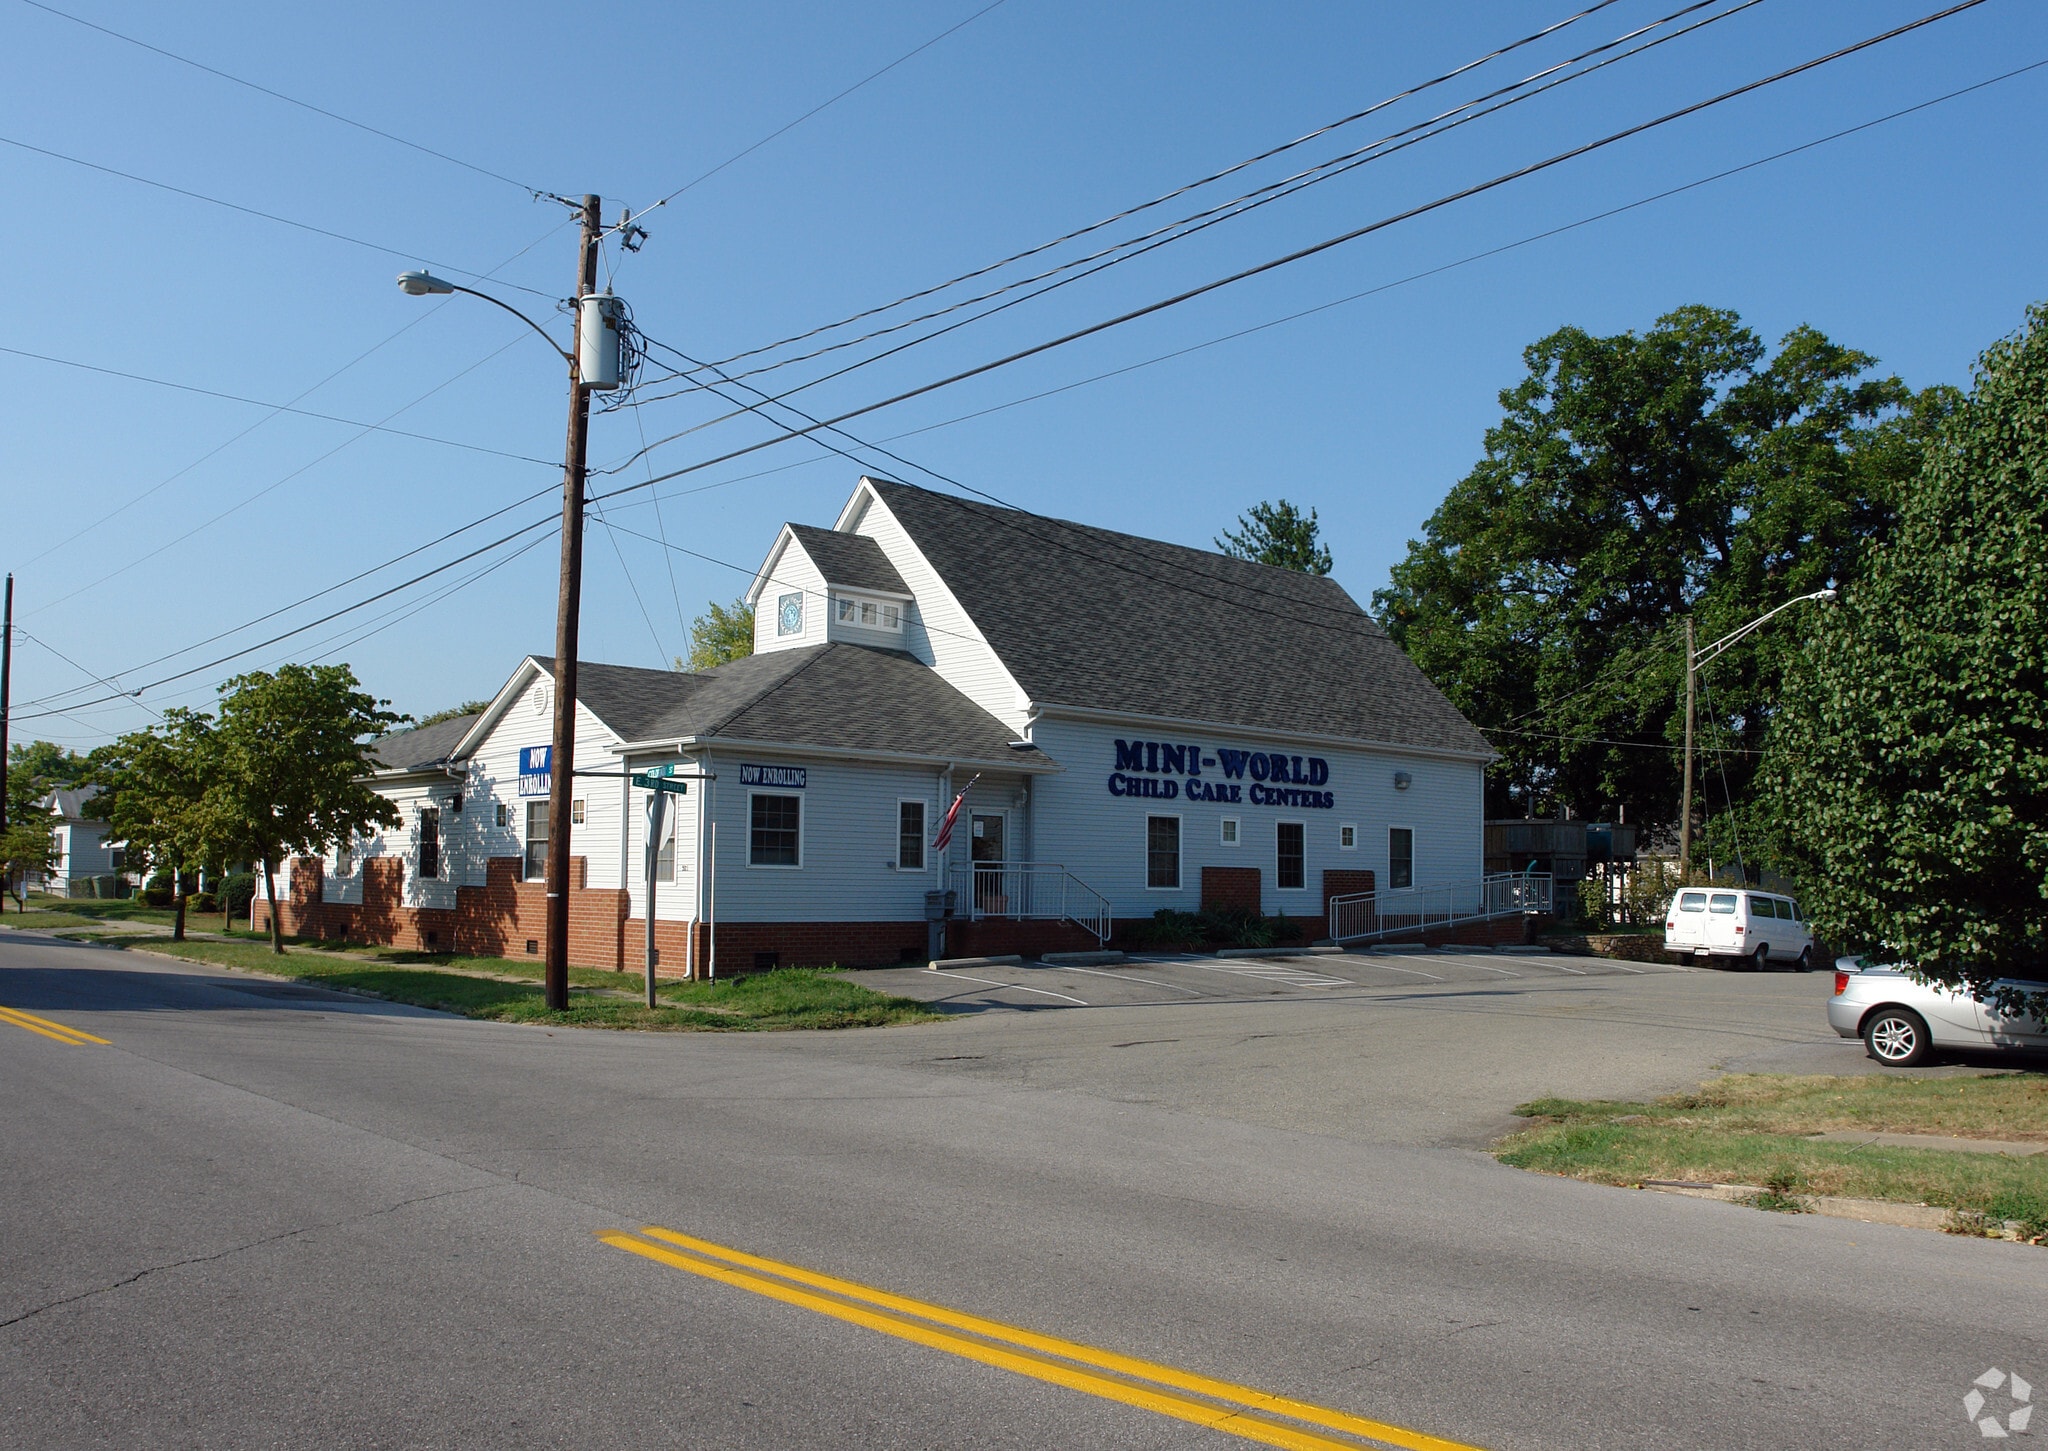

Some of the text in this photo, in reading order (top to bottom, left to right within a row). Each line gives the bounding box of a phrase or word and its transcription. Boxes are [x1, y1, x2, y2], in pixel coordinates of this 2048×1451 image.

[530, 747, 548, 769] NOW
[1114, 739, 1329, 786] MINI-WORLD
[520, 773, 552, 795] ENROLLIN
[644, 778, 660, 789] 3RD
[662, 781, 684, 792] STREET
[742, 766, 805, 786] NOW ENROLLING
[1108, 773, 1334, 809] CHILD CARE CENTERS
